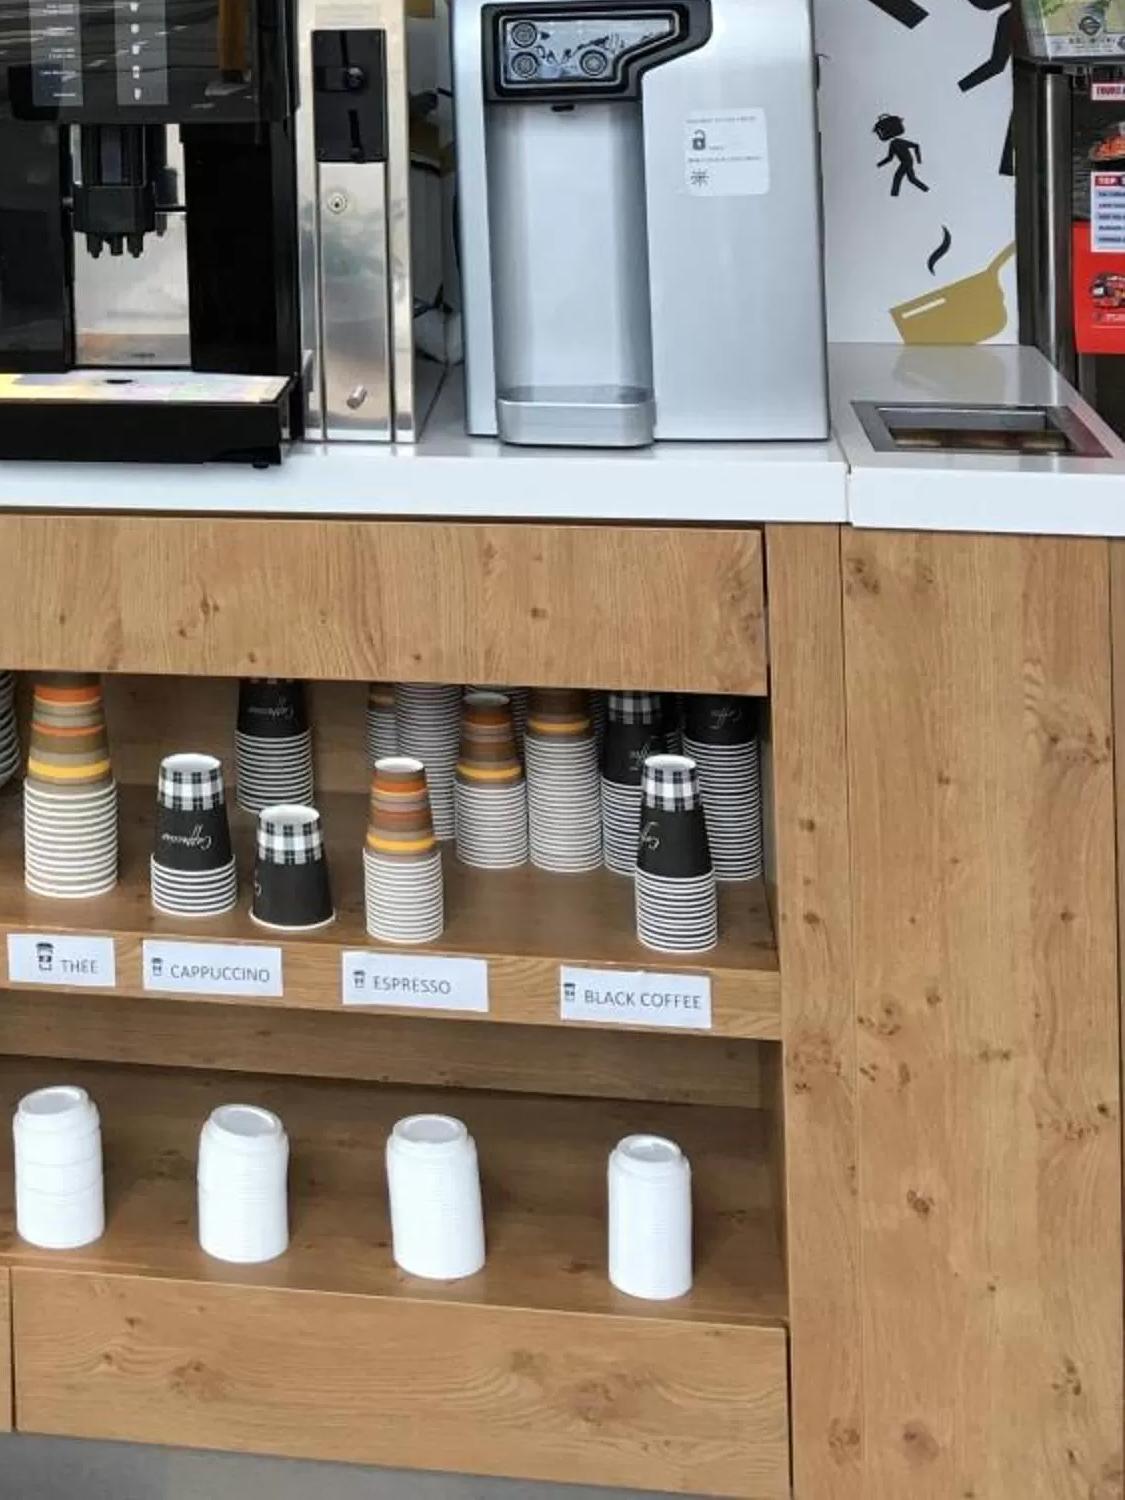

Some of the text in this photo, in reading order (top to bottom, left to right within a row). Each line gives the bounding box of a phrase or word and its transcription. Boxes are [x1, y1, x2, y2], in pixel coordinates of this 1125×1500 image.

[60, 959, 100, 974] THEE
[170, 964, 271, 983] CAPPUCCINO
[373, 975, 452, 996] ESPRESSO
[583, 989, 702, 1010] BLACK COFFEE
